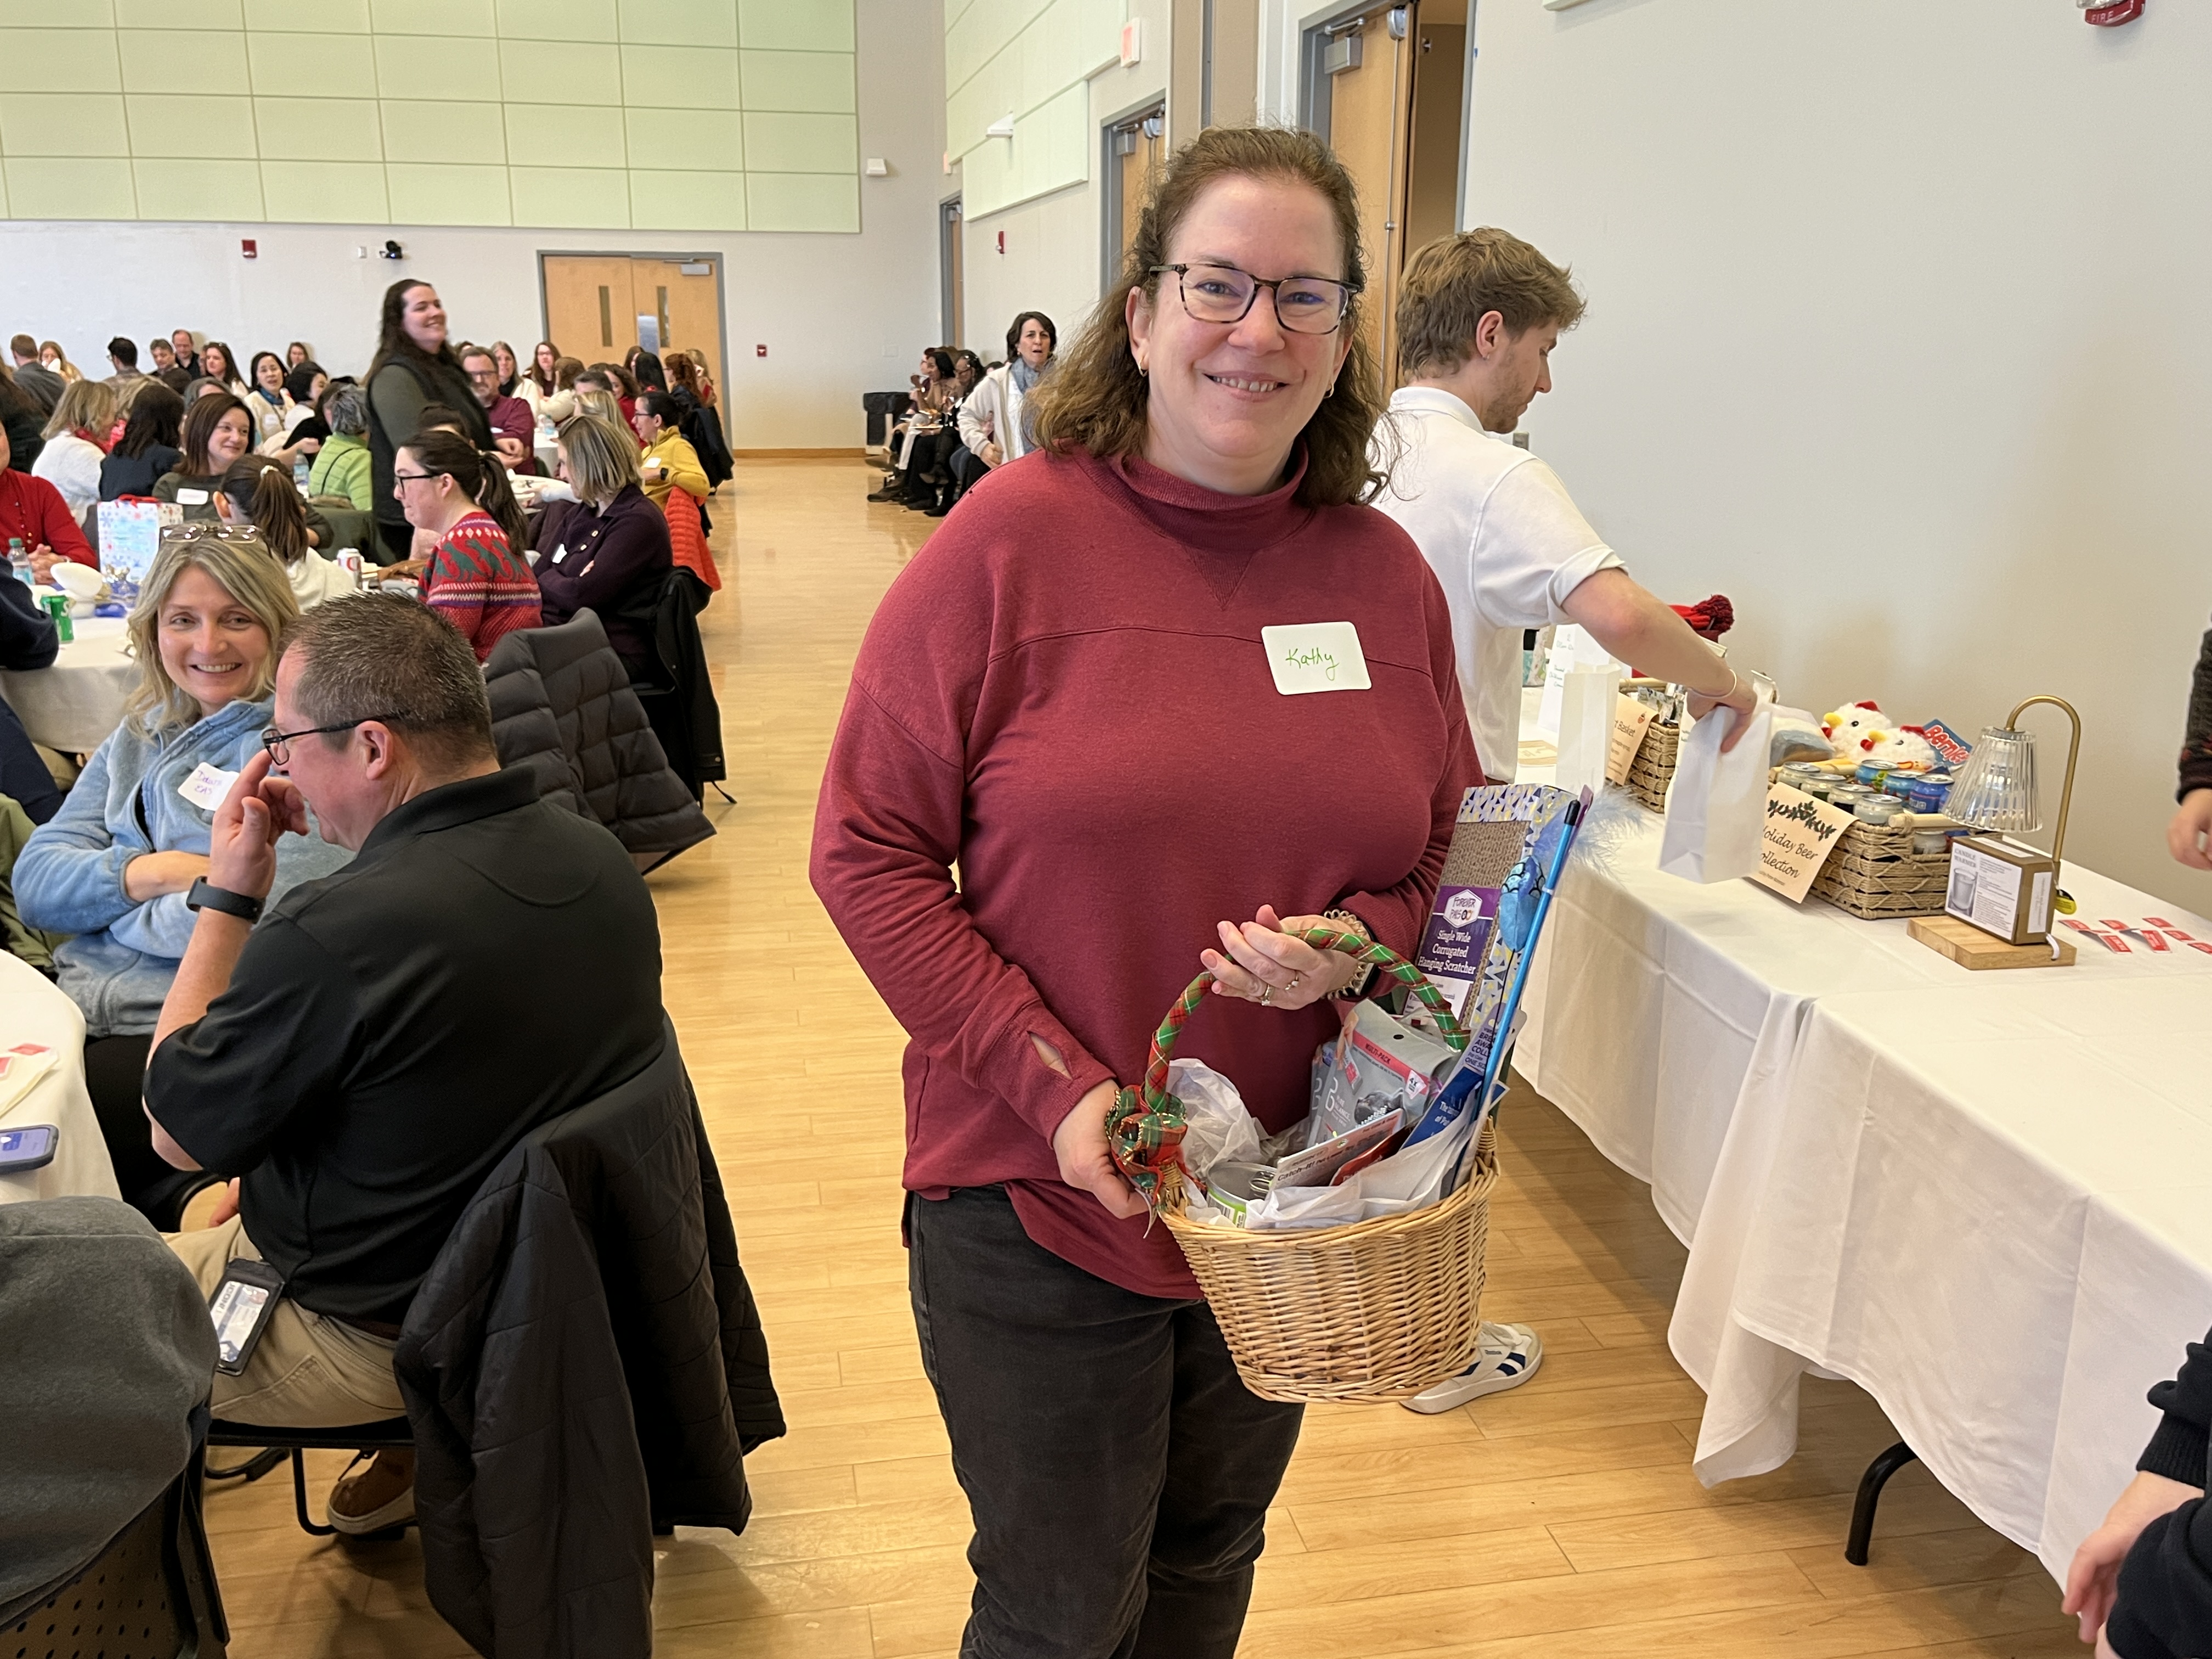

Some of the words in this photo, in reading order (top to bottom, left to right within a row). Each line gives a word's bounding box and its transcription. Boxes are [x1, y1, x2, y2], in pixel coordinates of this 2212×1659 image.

[2091, 10, 2114, 23] FIRE
[1285, 647, 1340, 681] Kathy
[1795, 843, 1819, 860] Beer
[1759, 850, 1801, 878] ollection
[1437, 930, 1455, 943] Single
[1455, 932, 1471, 943] Wide
[1432, 943, 1469, 958] Corrugated
[1418, 956, 1444, 972] Hanging
[1443, 960, 1476, 974] Scratcher
[1365, 1043, 1391, 1064] MULTI-PACK
[1477, 1062, 1486, 1070] SIZ
